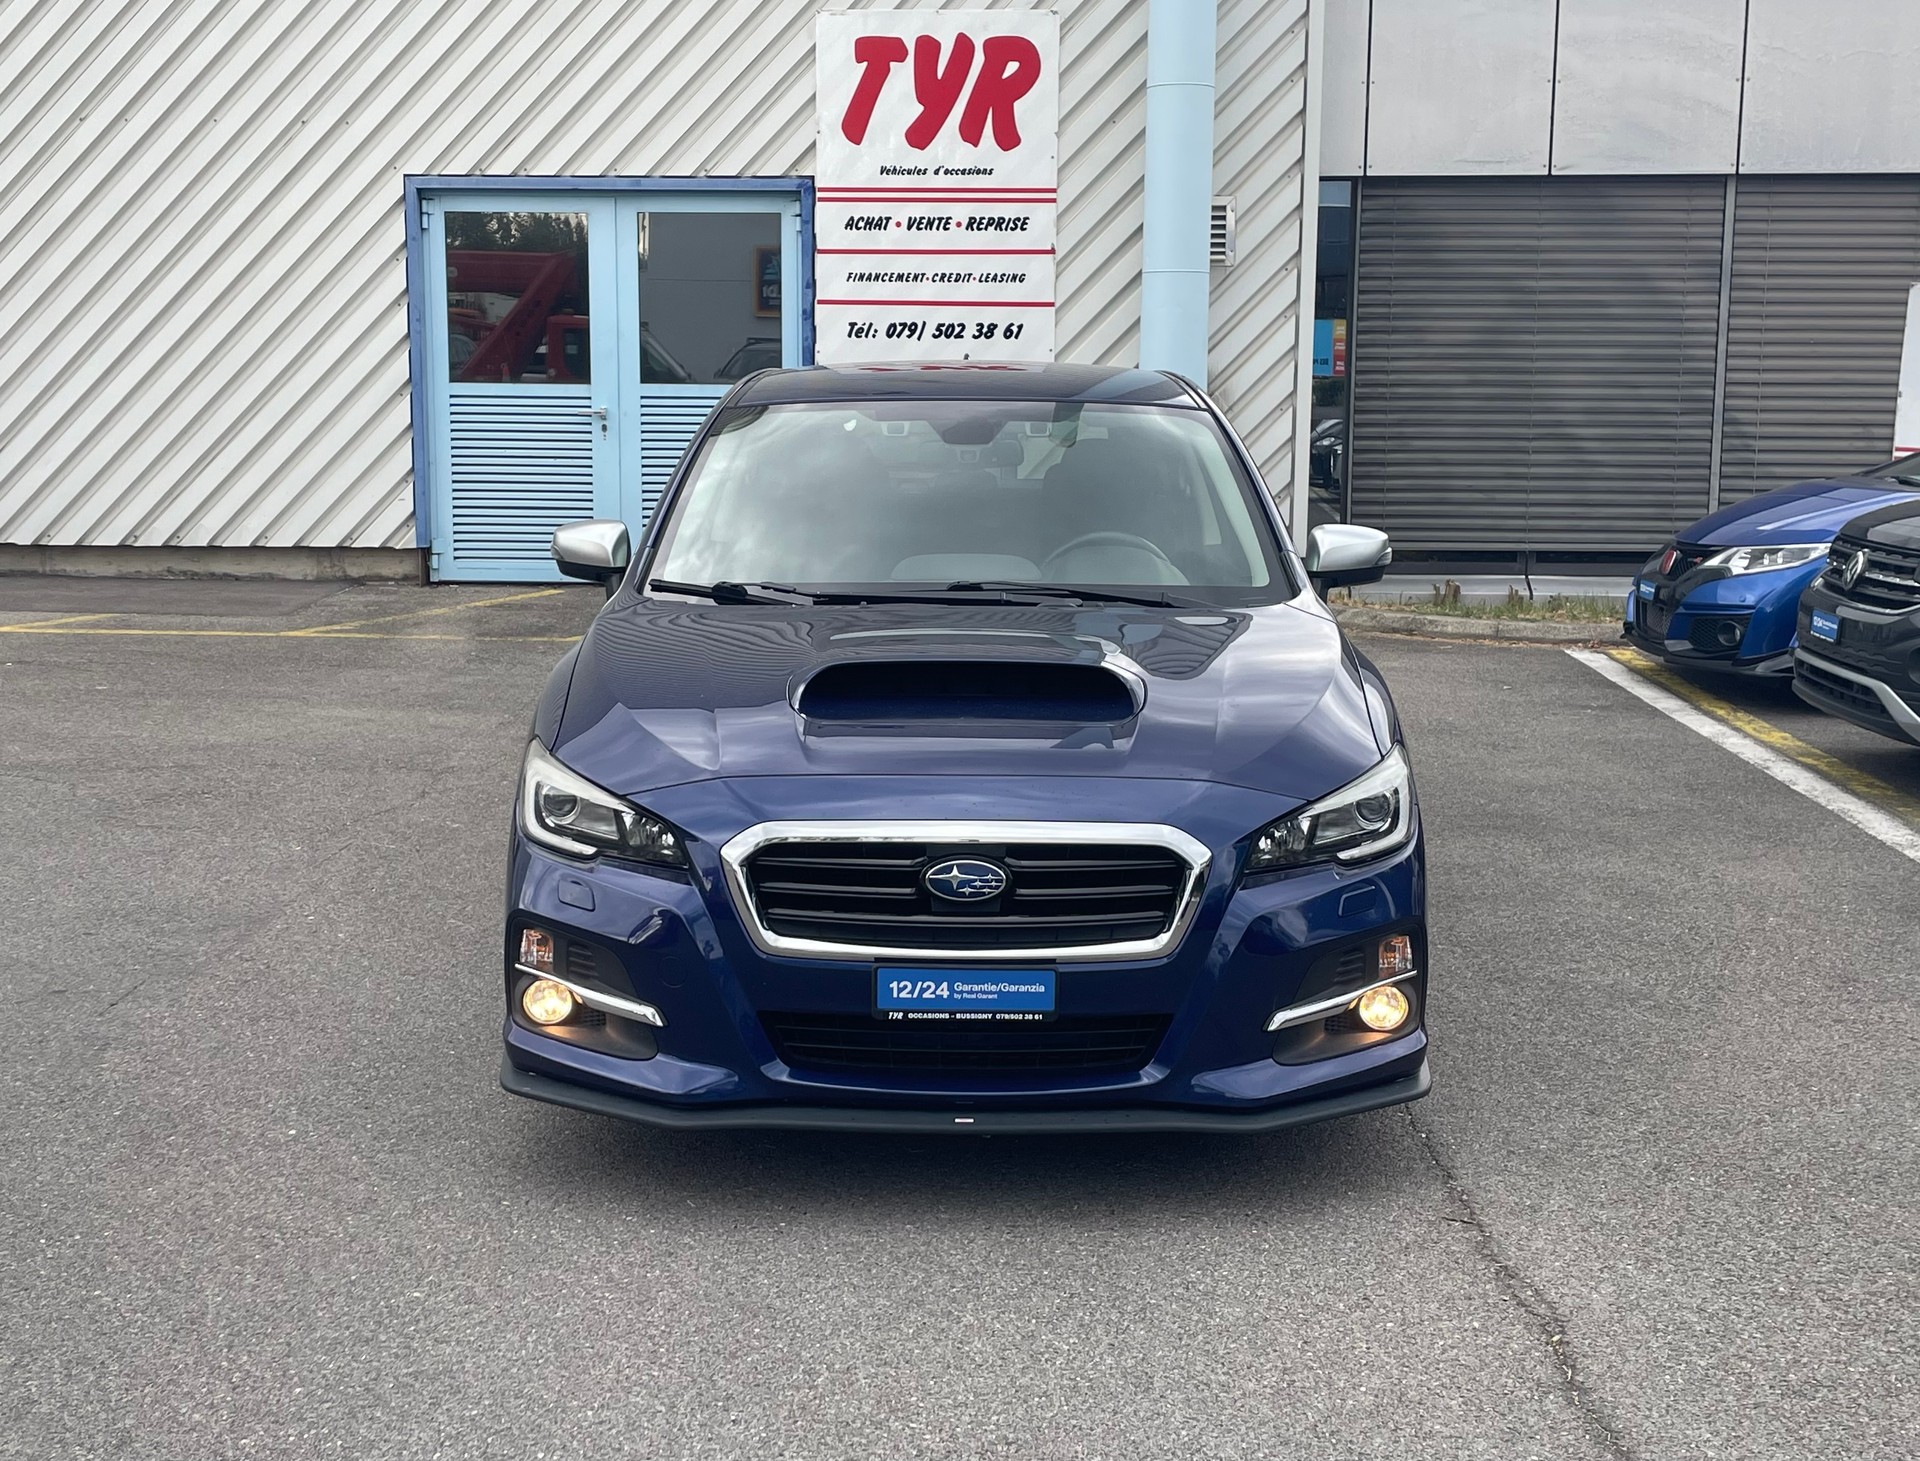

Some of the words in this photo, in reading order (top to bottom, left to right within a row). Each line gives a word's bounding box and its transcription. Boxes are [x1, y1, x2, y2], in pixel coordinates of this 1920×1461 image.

[841, 32, 1042, 152] TYR
[879, 165, 928, 176] Véhicules
[933, 165, 994, 176] d'occasions
[844, 216, 892, 231] ACHAT
[906, 216, 953, 232] VENTE
[965, 216, 1030, 232] REPRISE
[846, 272, 926, 283] FINANCEMENT
[931, 272, 974, 283] CREDIT
[978, 273, 1026, 283] LEASING
[847, 322, 878, 339] Tél:
[932, 322, 965, 340] 502
[972, 322, 998, 340] 38
[1003, 323, 1024, 340] 61
[889, 980, 950, 999] 12/24
[954, 982, 1045, 993] Garantie/Garanzia
